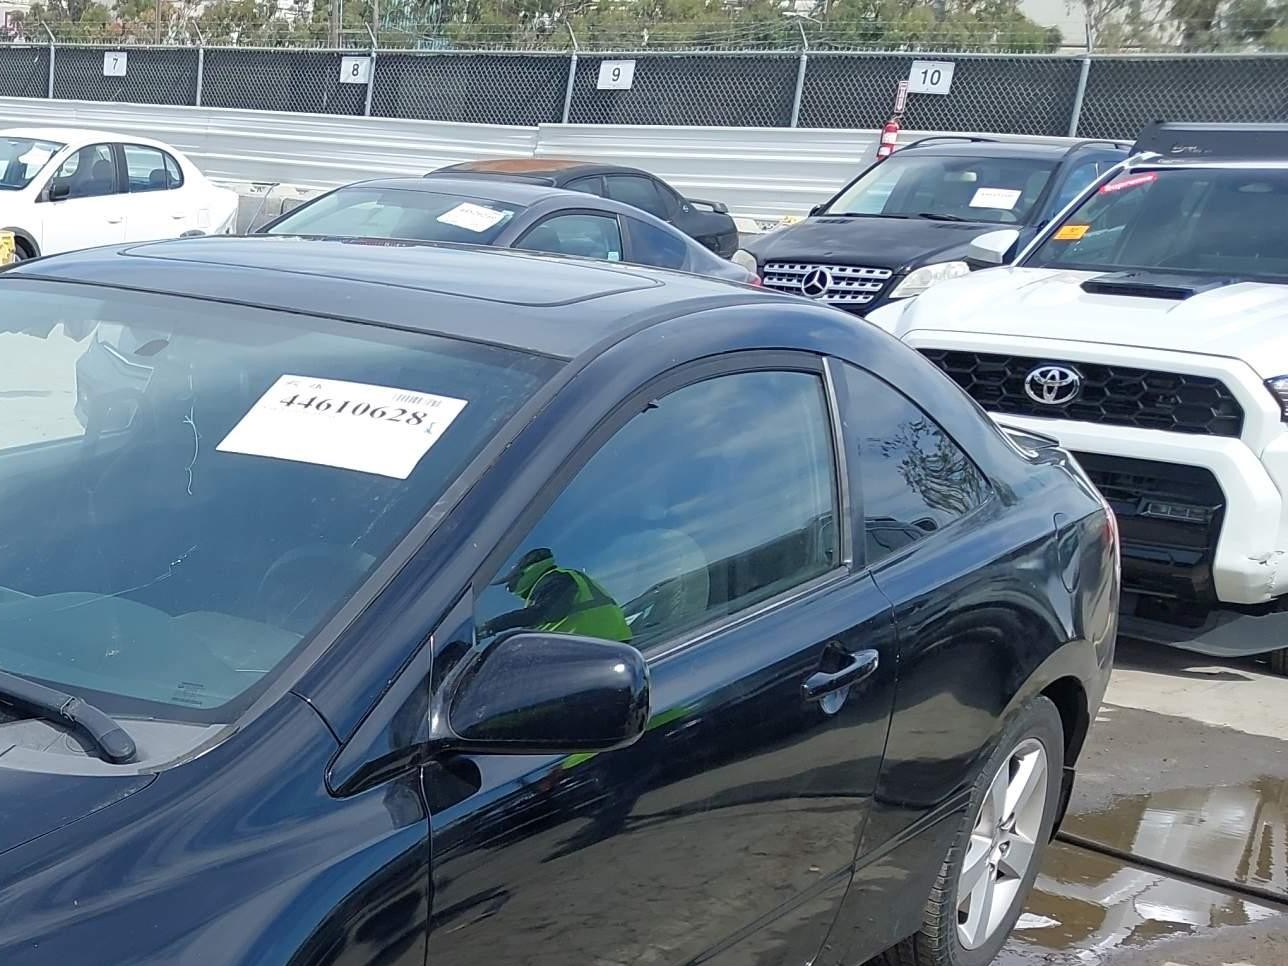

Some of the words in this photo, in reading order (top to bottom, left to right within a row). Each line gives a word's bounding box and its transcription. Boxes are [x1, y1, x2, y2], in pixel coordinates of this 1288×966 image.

[112, 57, 118, 70] 7
[352, 63, 360, 77] 8
[612, 67, 621, 82] 9
[921, 69, 941, 86] 10
[280, 394, 427, 426] 44610628
